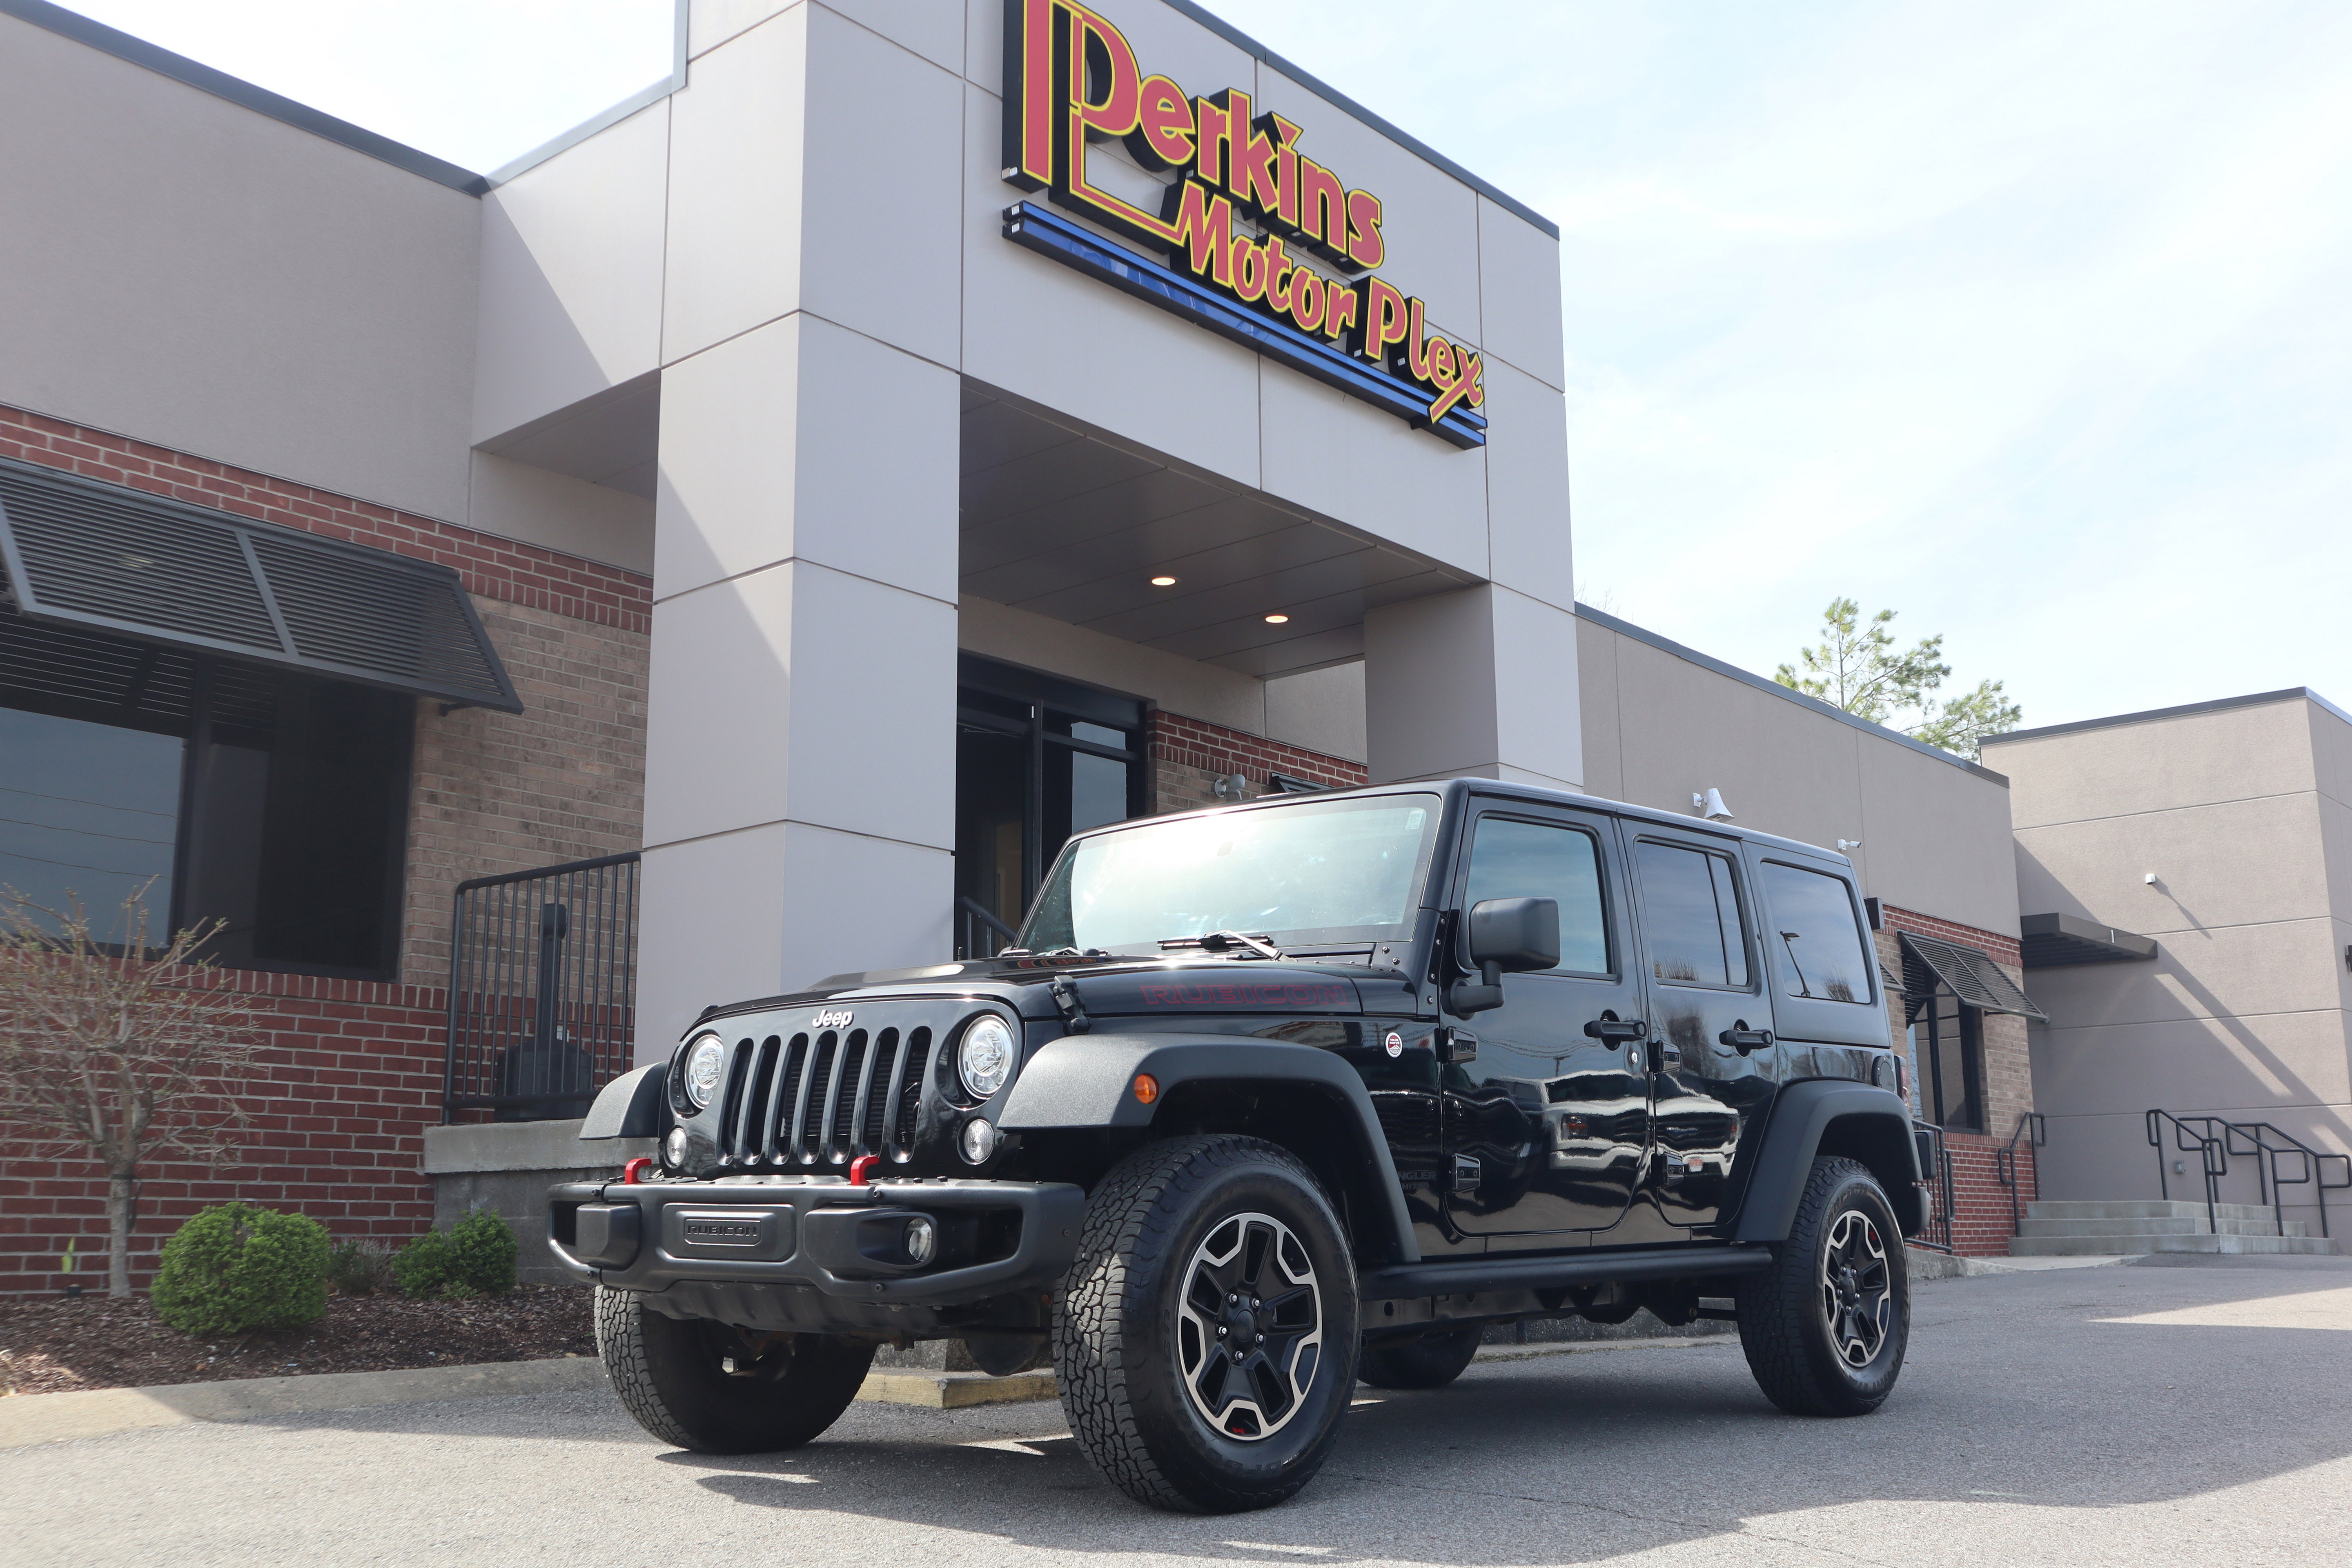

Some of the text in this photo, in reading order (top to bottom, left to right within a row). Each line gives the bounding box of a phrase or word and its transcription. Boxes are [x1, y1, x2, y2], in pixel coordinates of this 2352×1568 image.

[1022, 0, 1385, 269] Perkins
[1174, 178, 1484, 424] Motor Plex
[1140, 984, 1348, 1005] RUBICON
[812, 1009, 854, 1029] Jeep
[1397, 1171, 1437, 1180] NGLER
[687, 1225, 757, 1236] RUBICON
[1161, 1307, 1282, 1480] BFGoodrich
